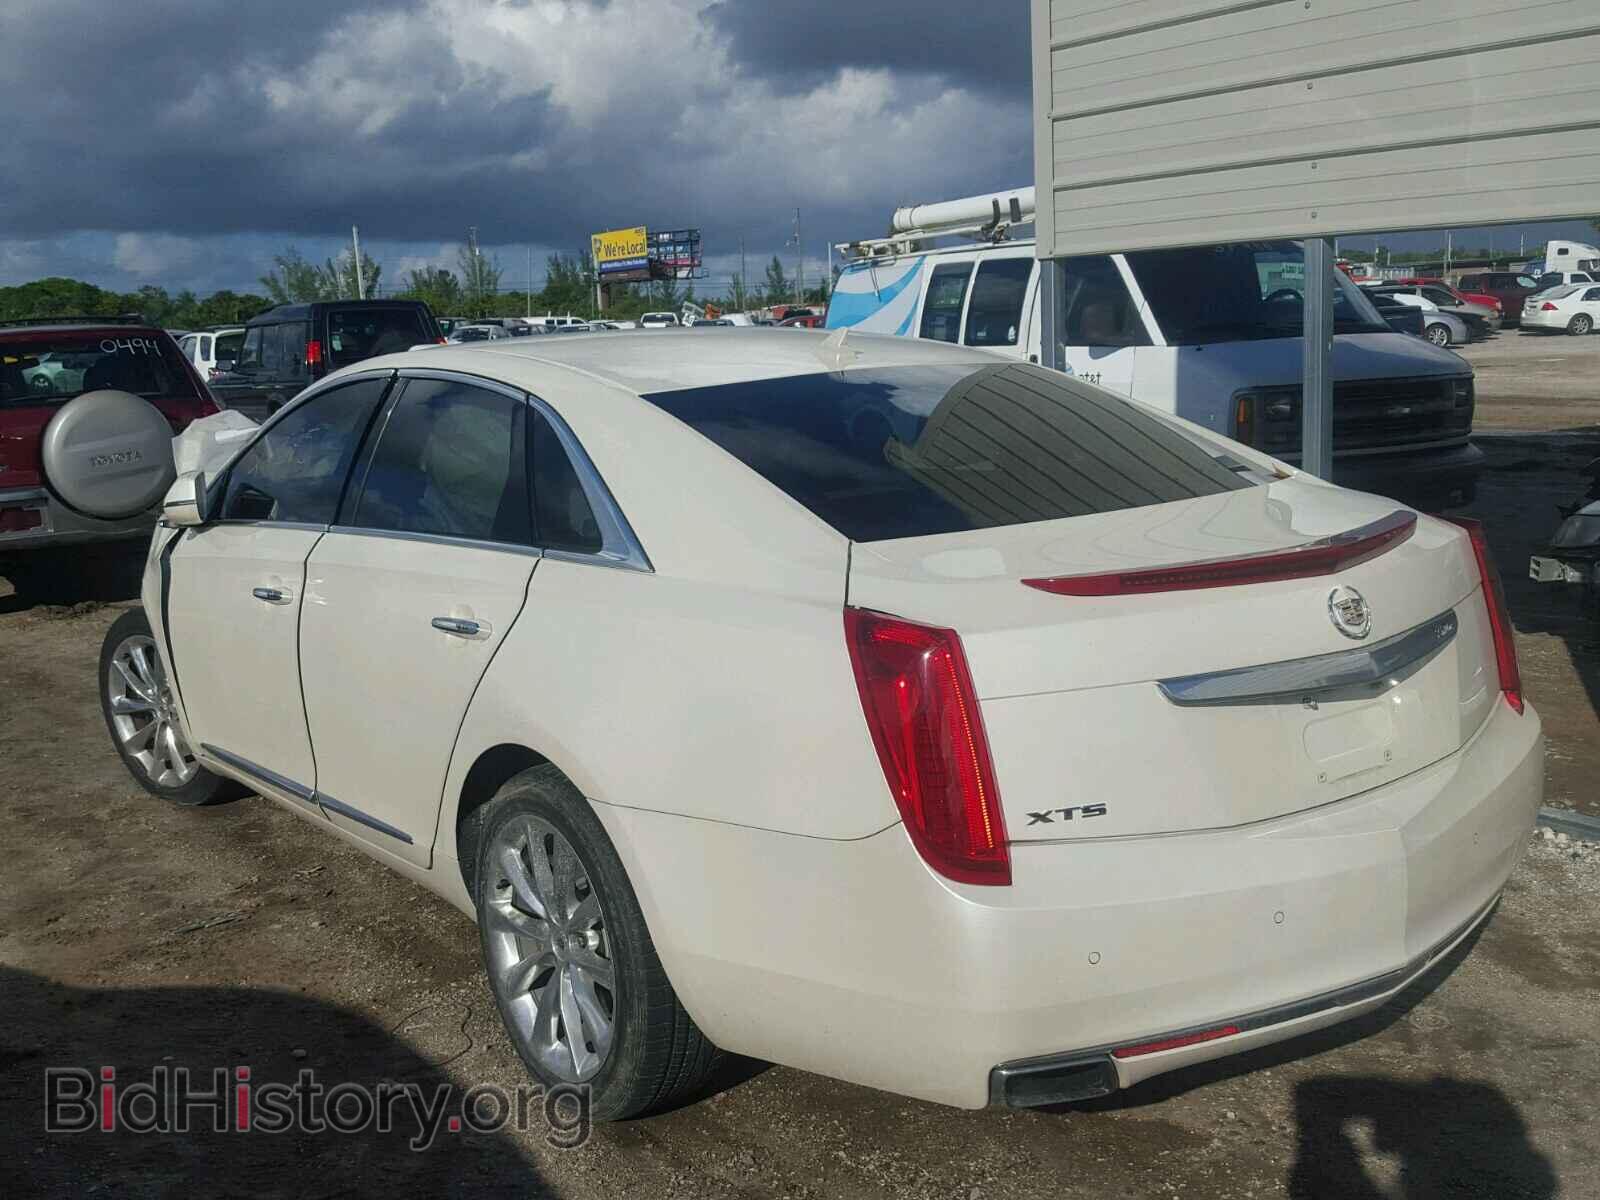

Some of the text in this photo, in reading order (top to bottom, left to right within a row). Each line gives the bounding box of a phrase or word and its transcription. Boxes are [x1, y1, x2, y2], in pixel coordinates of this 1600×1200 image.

[604, 240, 626, 257] We're
[627, 238, 647, 255] Local
[100, 337, 162, 357] 0494
[90, 448, 142, 467] TOYOTA
[1026, 803, 1107, 826] XTS
